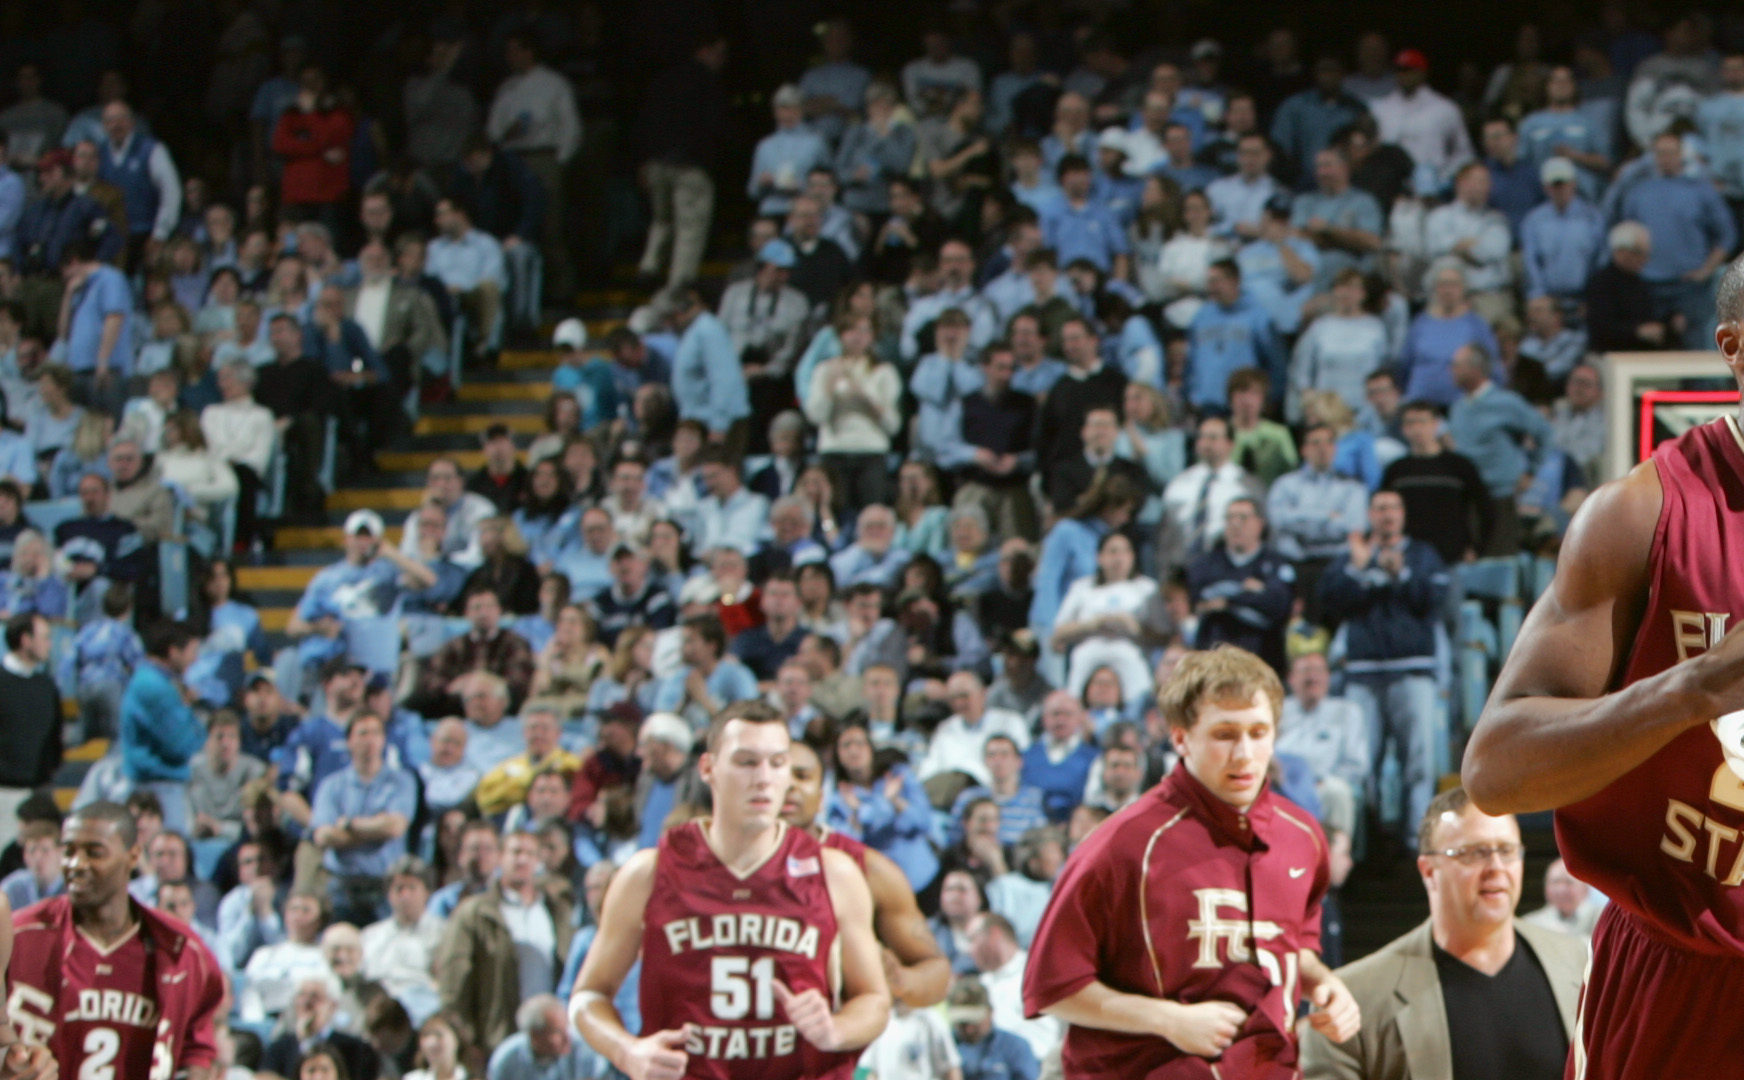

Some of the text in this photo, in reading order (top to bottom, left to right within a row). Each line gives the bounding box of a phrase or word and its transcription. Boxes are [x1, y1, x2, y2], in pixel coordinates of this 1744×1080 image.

[663, 912, 820, 960] FLORIDA
[710, 956, 775, 1020] 51
[684, 1024, 797, 1060] STATE
